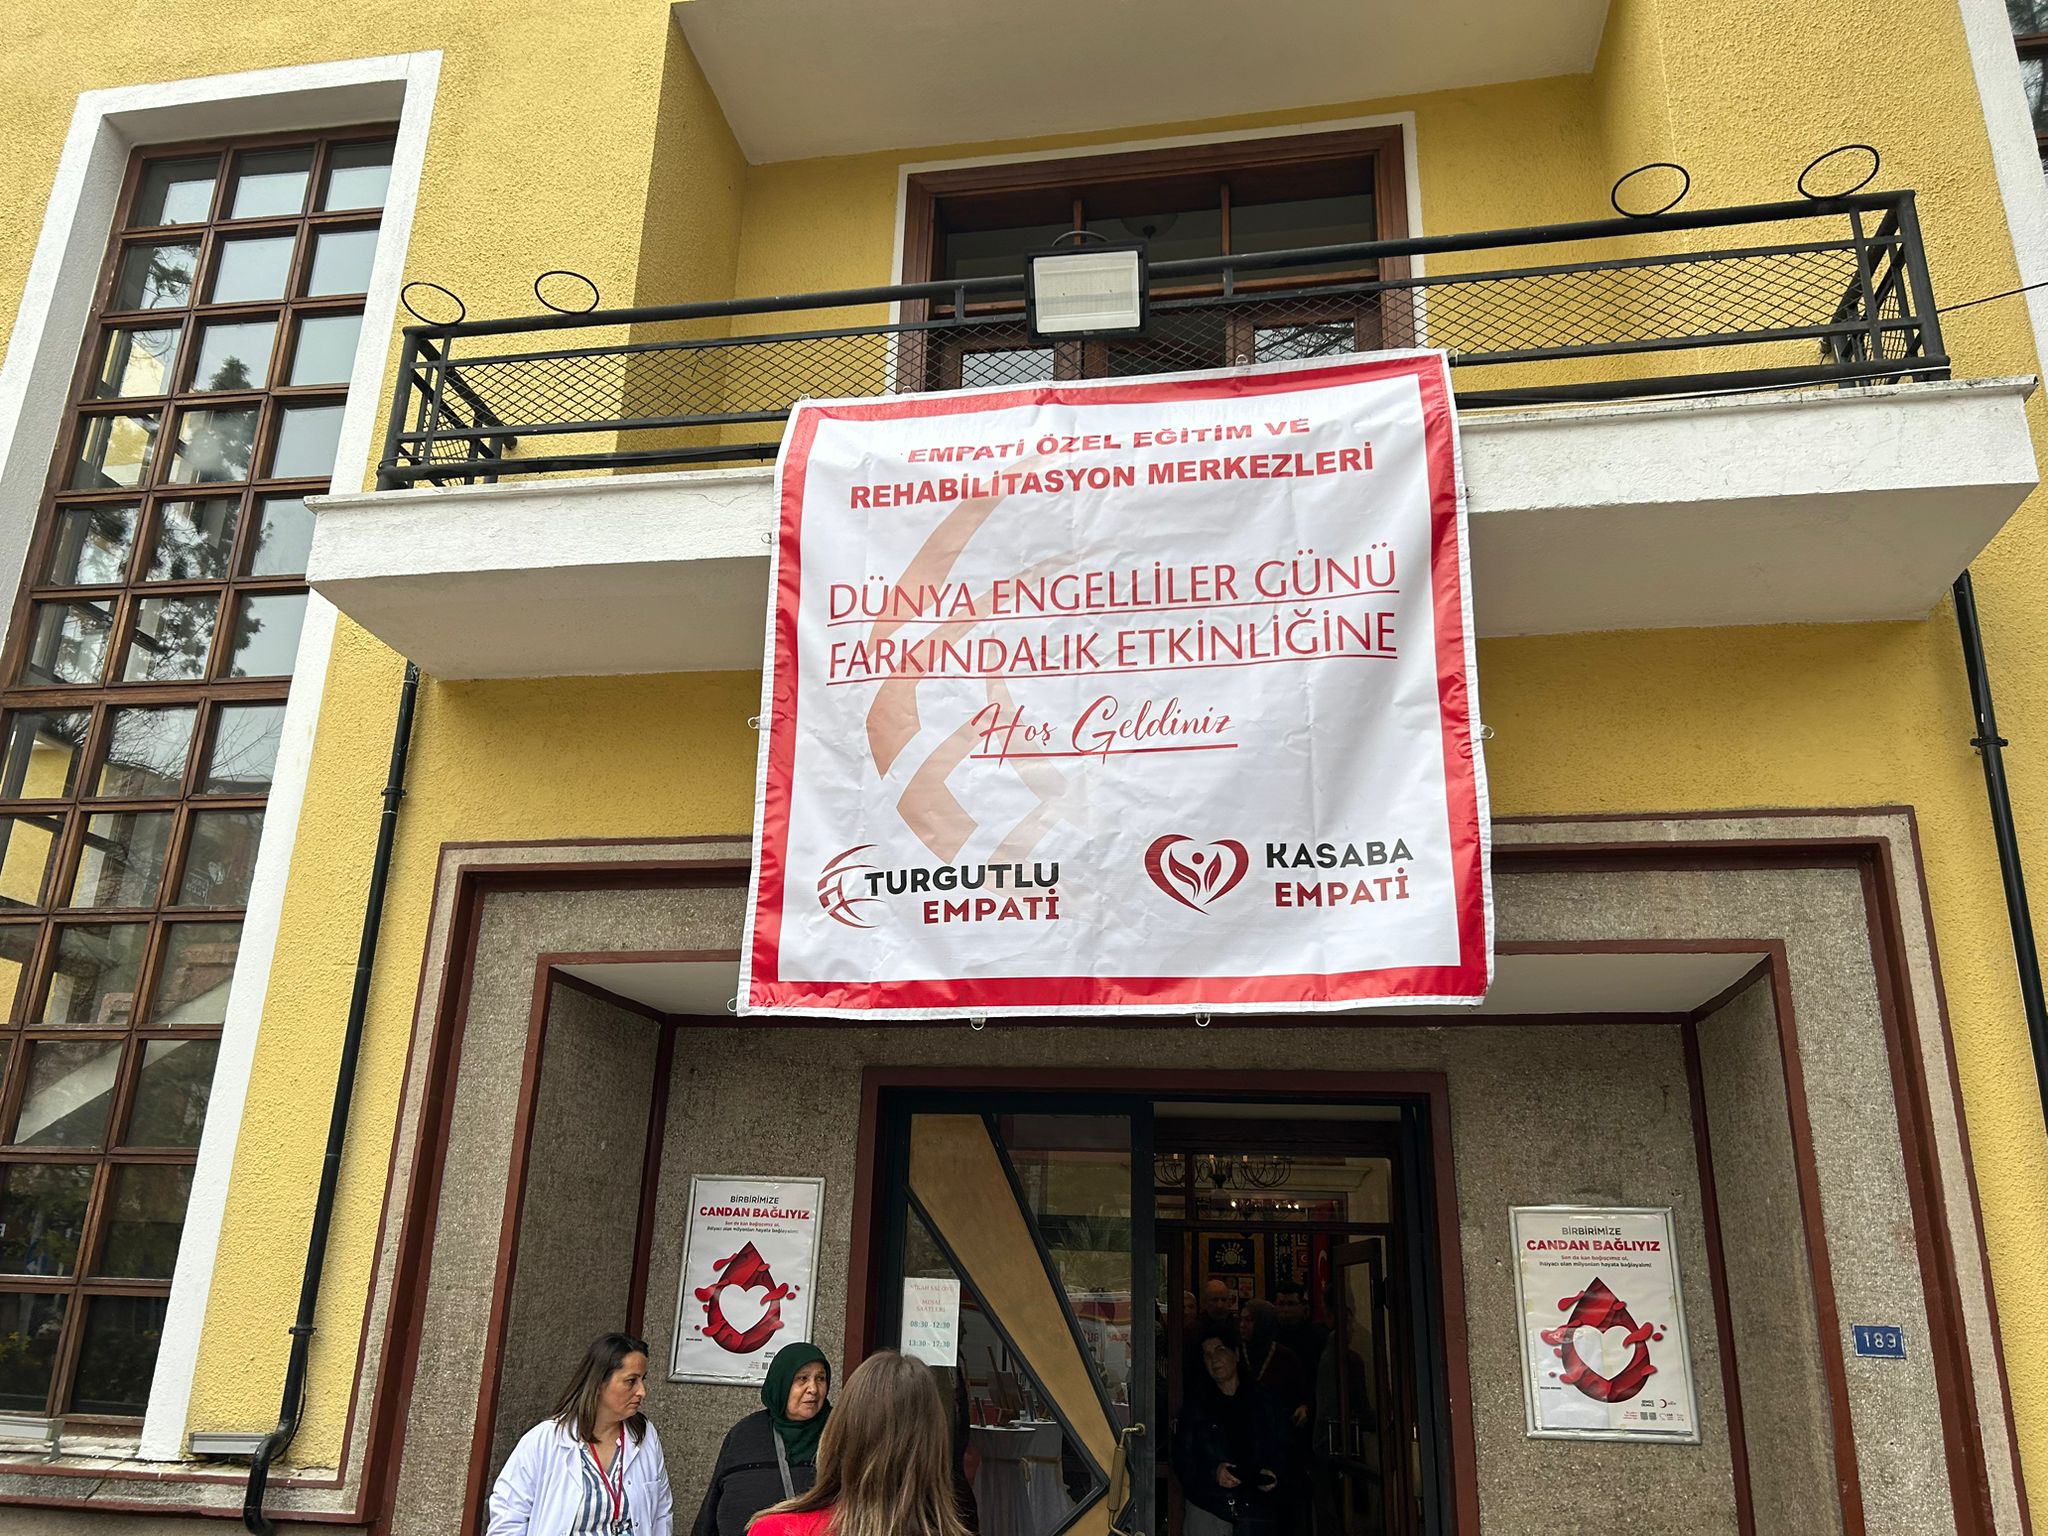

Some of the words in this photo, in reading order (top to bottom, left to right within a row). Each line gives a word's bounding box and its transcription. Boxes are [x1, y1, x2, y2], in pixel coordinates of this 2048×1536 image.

[908, 438, 1025, 463] EMPATİ
[1036, 433, 1121, 456] ÖZEL
[1133, 424, 1252, 448] EĞİTİM
[1264, 418, 1310, 436] VE
[850, 466, 1135, 509] REHABİLİTASYON
[1148, 441, 1374, 485] MERKEZLERİ
[830, 575, 976, 620] DÜNYA
[992, 561, 1238, 615] ENGELLİLER
[1254, 542, 1396, 598] GÜNÜ
[829, 632, 1100, 679] FARKINDALIK
[1118, 607, 1397, 667] ETKİNLİĞİNE
[971, 702, 1058, 768] Hoş
[1071, 695, 1235, 765] Geldiniz
[1266, 838, 1414, 868] KASABA
[864, 862, 1060, 896] TURGUTLU
[1275, 867, 1410, 907] EMPATİ
[923, 888, 1060, 924] EMPATİ
[700, 1206, 750, 1217] CANDAN
[752, 1206, 810, 1220] BAĞLIYIZ
[730, 1195, 780, 1205] BİRBİRİMİZE
[1526, 1239, 1589, 1251] CANDAN
[1593, 1237, 1661, 1252] BAĞLIYIZ
[1562, 1226, 1622, 1236] BİRBİRİMİZE
[910, 1320, 928, 1328] 08:30
[932, 1321, 950, 1329] 12:30
[1863, 1332, 1896, 1349] 183
